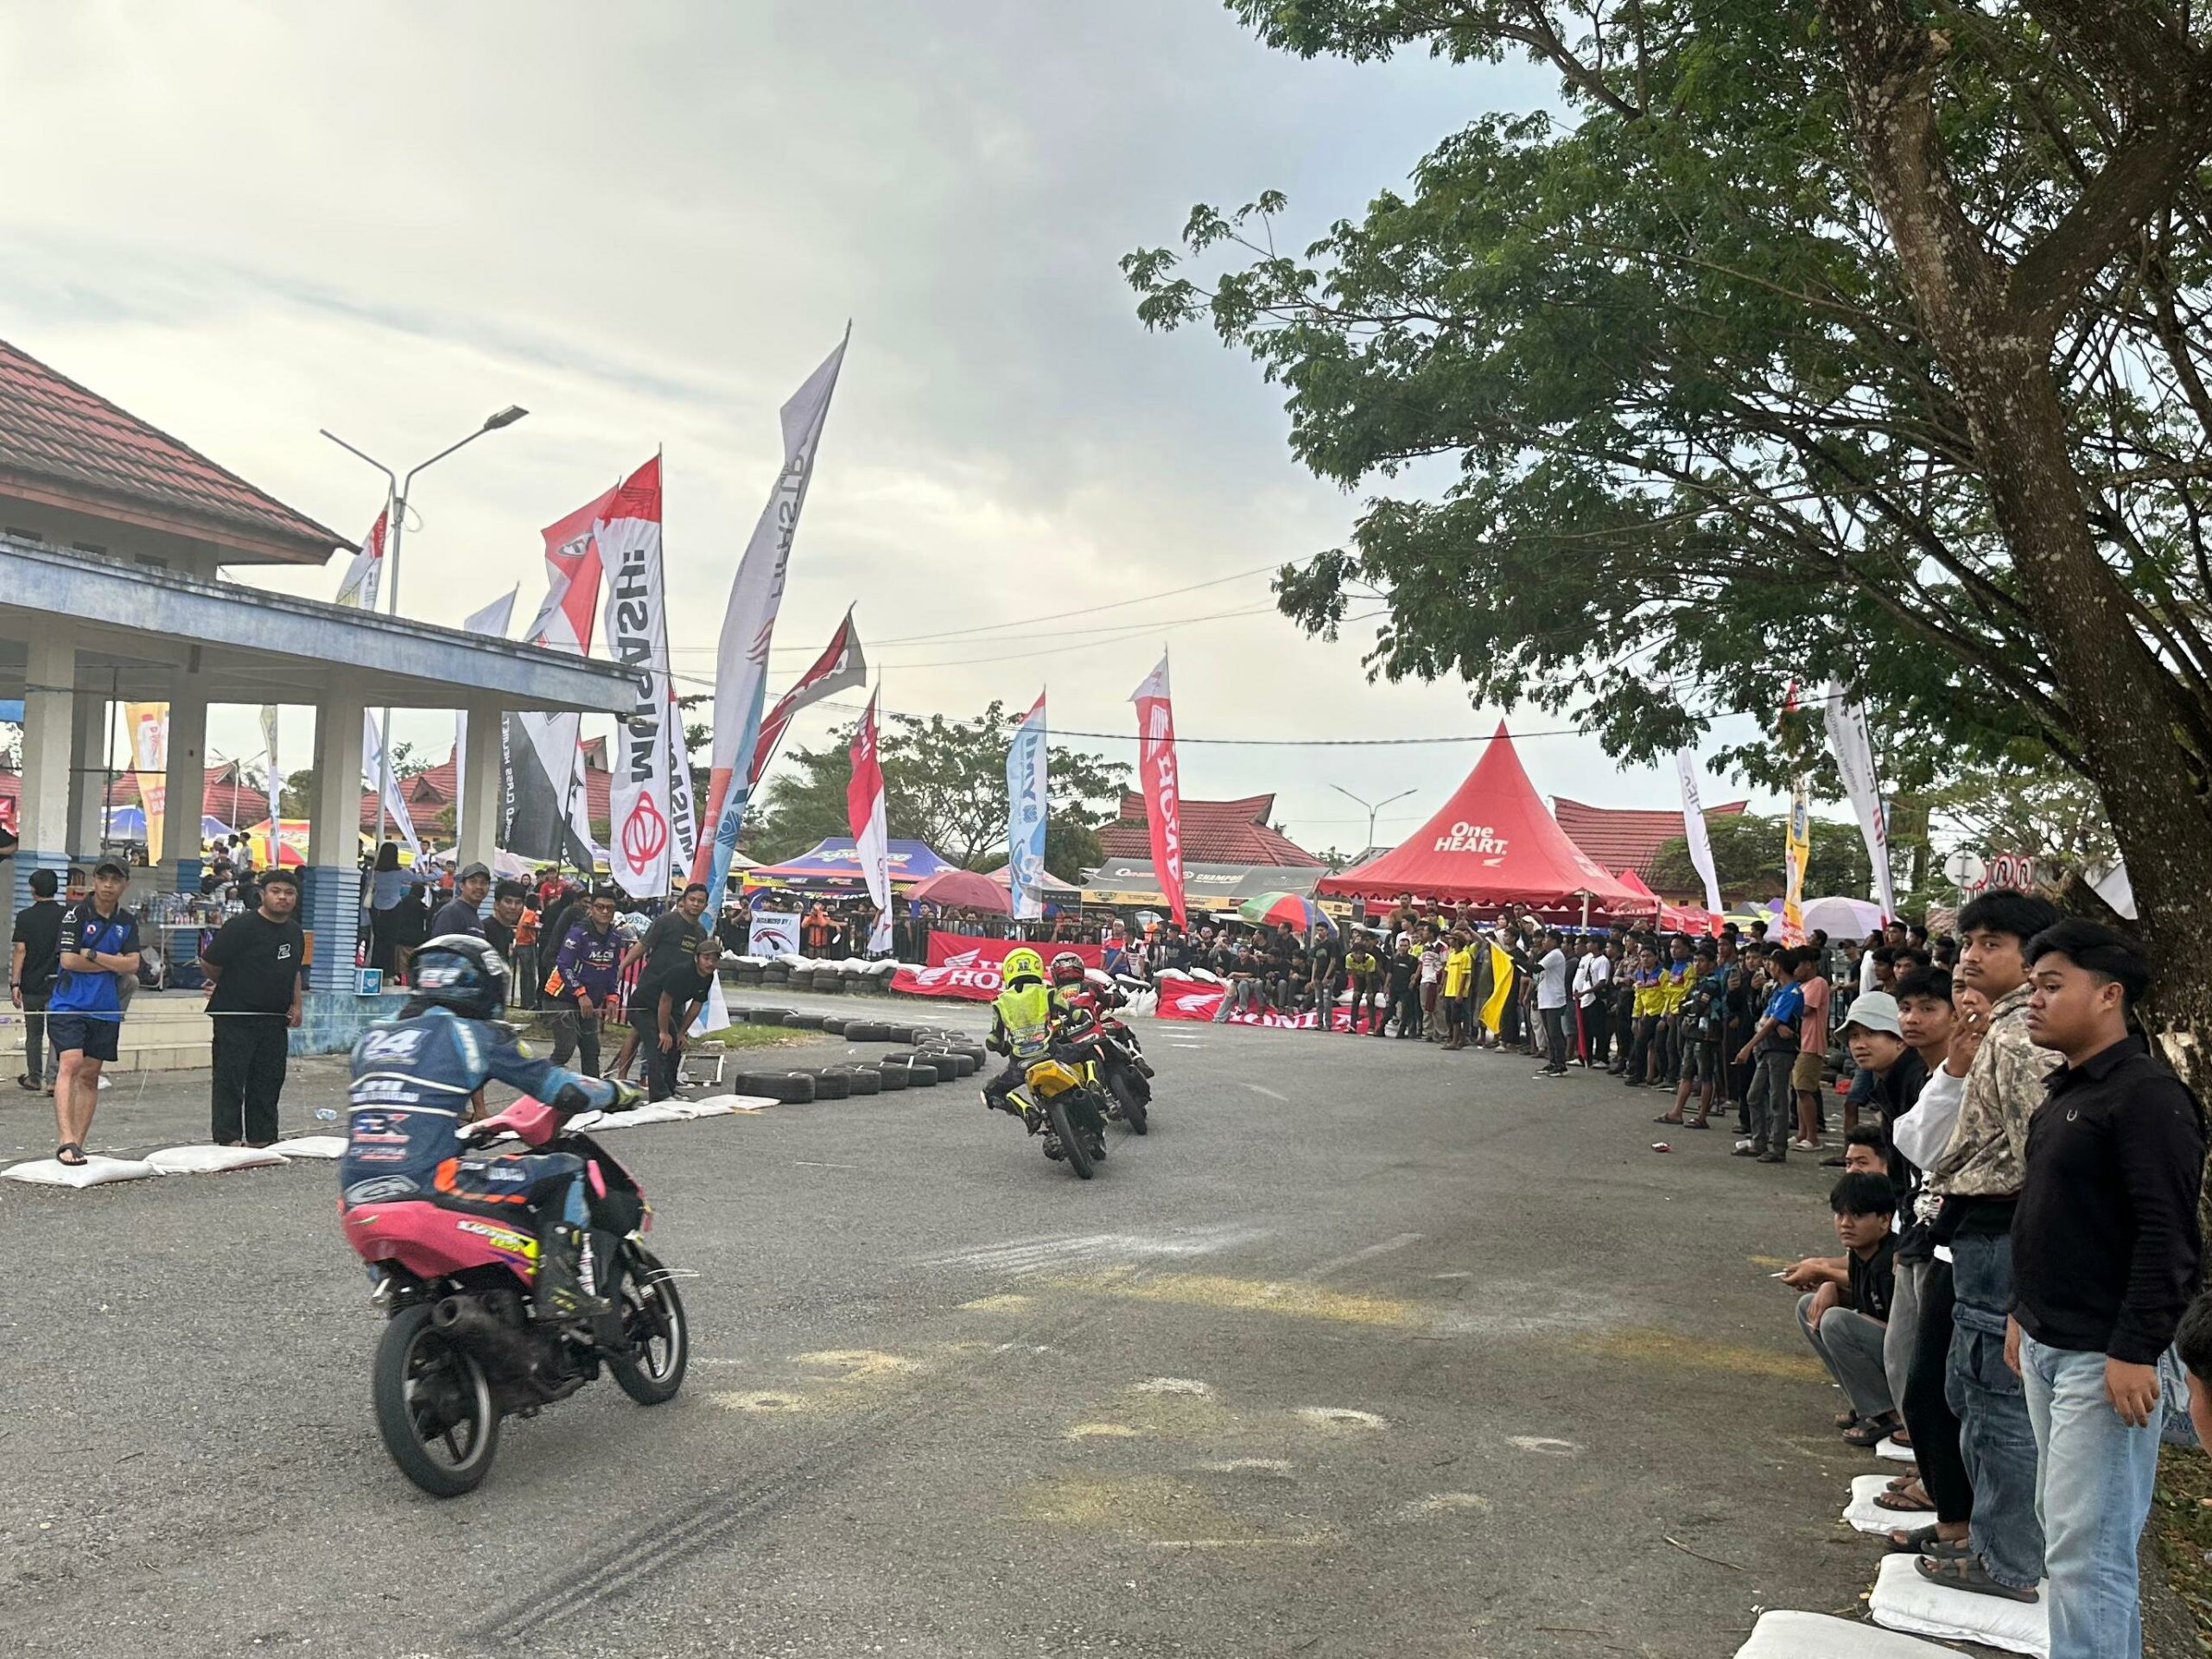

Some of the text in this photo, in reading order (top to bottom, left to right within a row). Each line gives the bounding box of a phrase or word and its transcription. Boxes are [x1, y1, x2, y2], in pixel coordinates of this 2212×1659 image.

[1450, 821, 1495, 839] One
[1433, 836, 1509, 855] HEART.
[363, 1028, 426, 1057] 24
